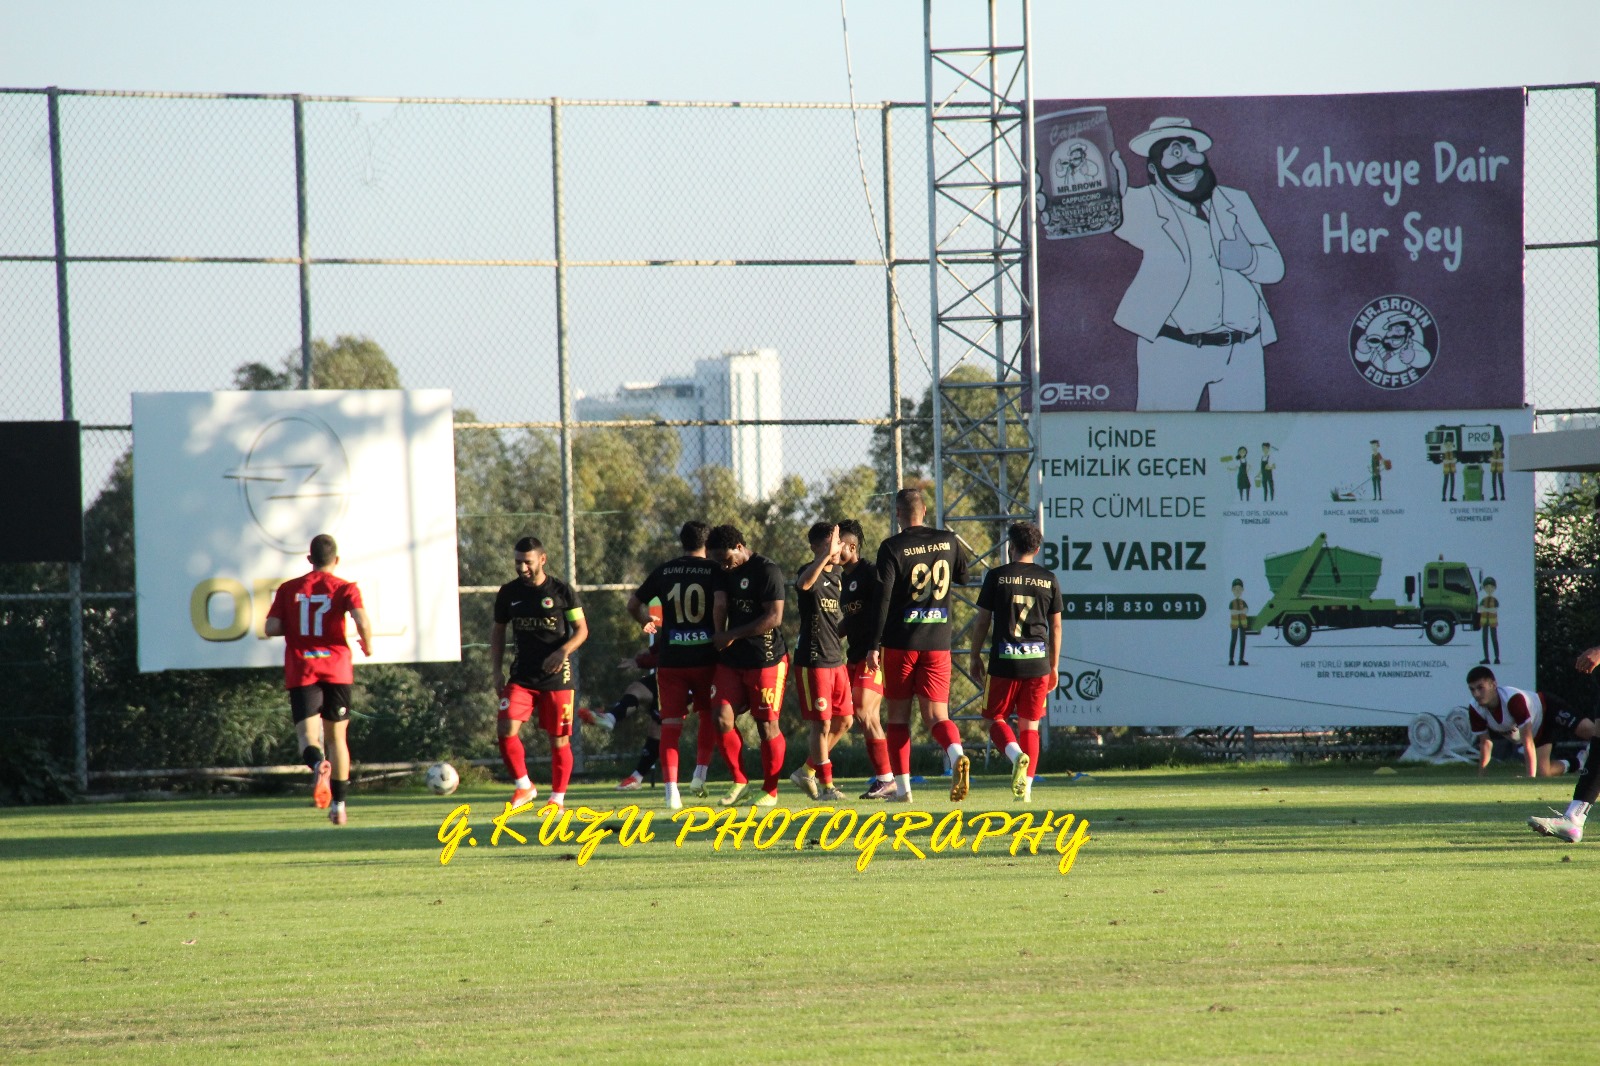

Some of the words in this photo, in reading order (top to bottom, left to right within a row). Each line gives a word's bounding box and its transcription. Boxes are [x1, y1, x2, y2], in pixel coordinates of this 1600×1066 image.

[1276, 145, 1420, 207] Kahveye
[1434, 140, 1510, 184] Dair
[1322, 211, 1390, 254] Her
[1403, 211, 1463, 272] Şey
[1363, 365, 1419, 387] COFFEE
[1088, 426, 1156, 451] İÇİNDE
[1041, 455, 1131, 477] TEMİZLİK
[1137, 458, 1206, 479] GEÇEN
[1092, 493, 1206, 518] CÜMLEDE
[927, 542, 951, 553] FARM
[1044, 535, 1092, 571] BİZ
[1102, 541, 1207, 571] VARIZ
[686, 567, 712, 575] FARM
[911, 559, 950, 602] 99
[1025, 577, 1052, 589] FARM
[667, 582, 706, 624] 10
[910, 610, 942, 619] aksa
[1085, 601, 1114, 612] 548
[1123, 601, 1153, 612] 830
[1162, 601, 1200, 612] 0911
[295, 593, 332, 637] 17
[1013, 594, 1036, 637] 7
[674, 631, 708, 642] aksa
[1004, 644, 1040, 655] aksa
[1300, 661, 1316, 669] HER
[1363, 660, 1390, 668] KOVASI
[1317, 670, 1329, 678] BİR
[1331, 670, 1375, 678] TELEFONLA
[761, 687, 775, 704] 16
[1055, 669, 1103, 701] RO
